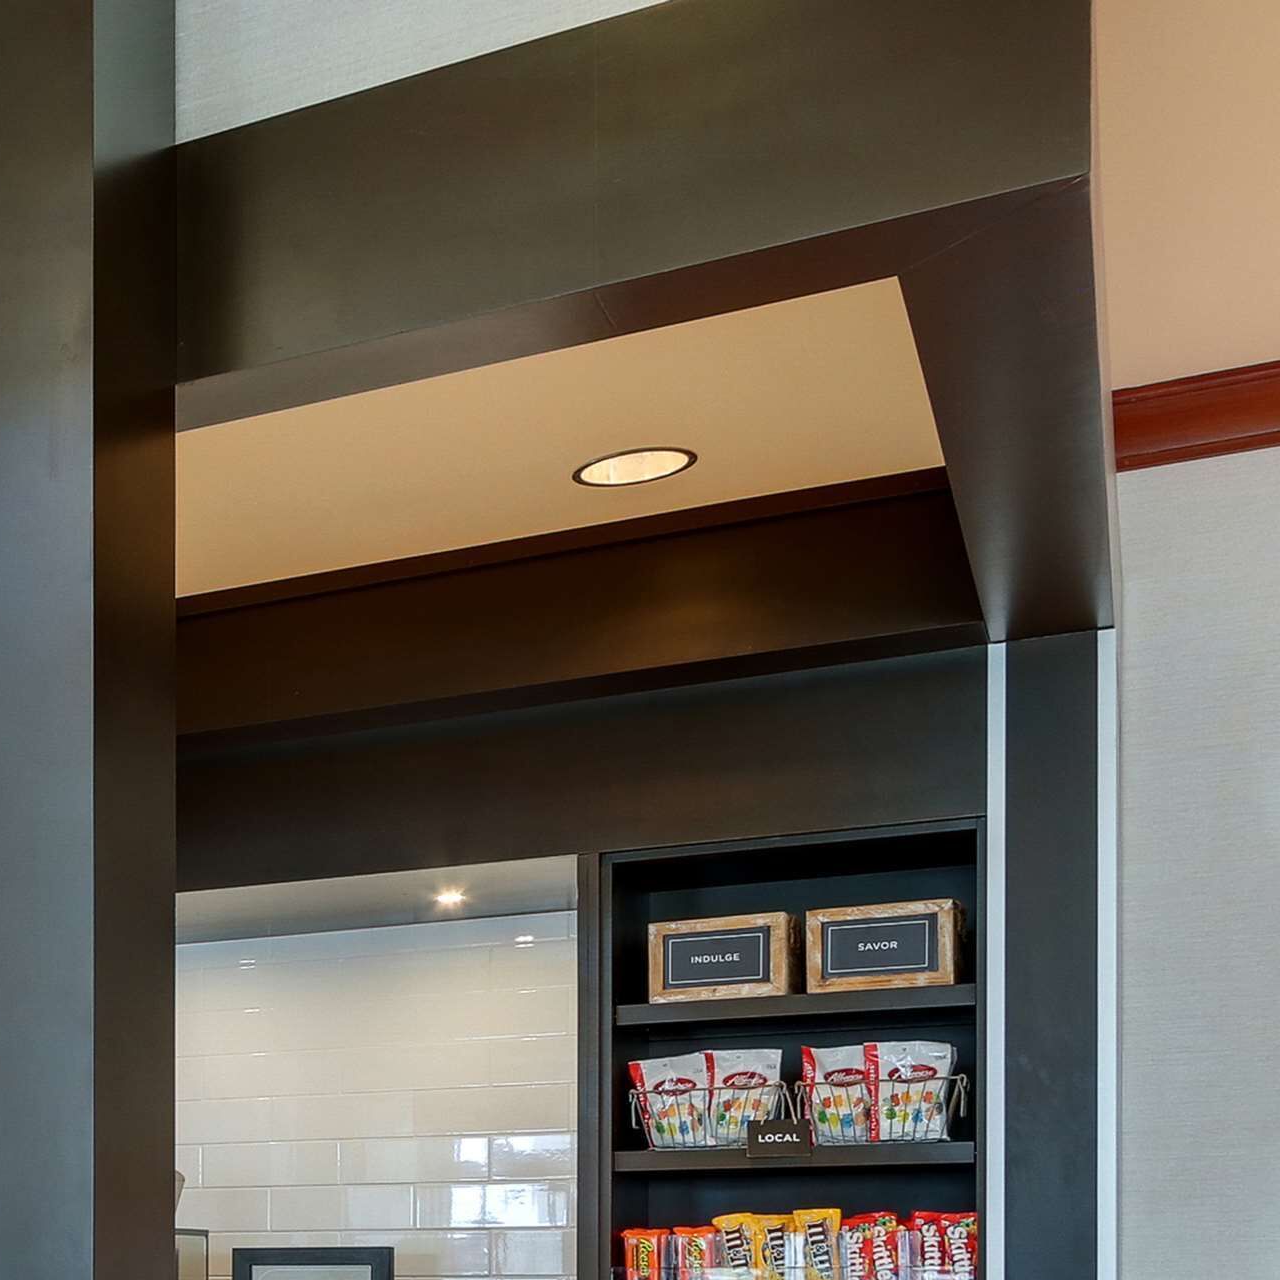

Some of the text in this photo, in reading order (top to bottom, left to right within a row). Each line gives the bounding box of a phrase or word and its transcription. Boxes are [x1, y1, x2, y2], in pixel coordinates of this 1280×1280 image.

[857, 940, 898, 952] SAVOR
[690, 953, 740, 964] INDULGE
[756, 1132, 801, 1144] LOCAL
